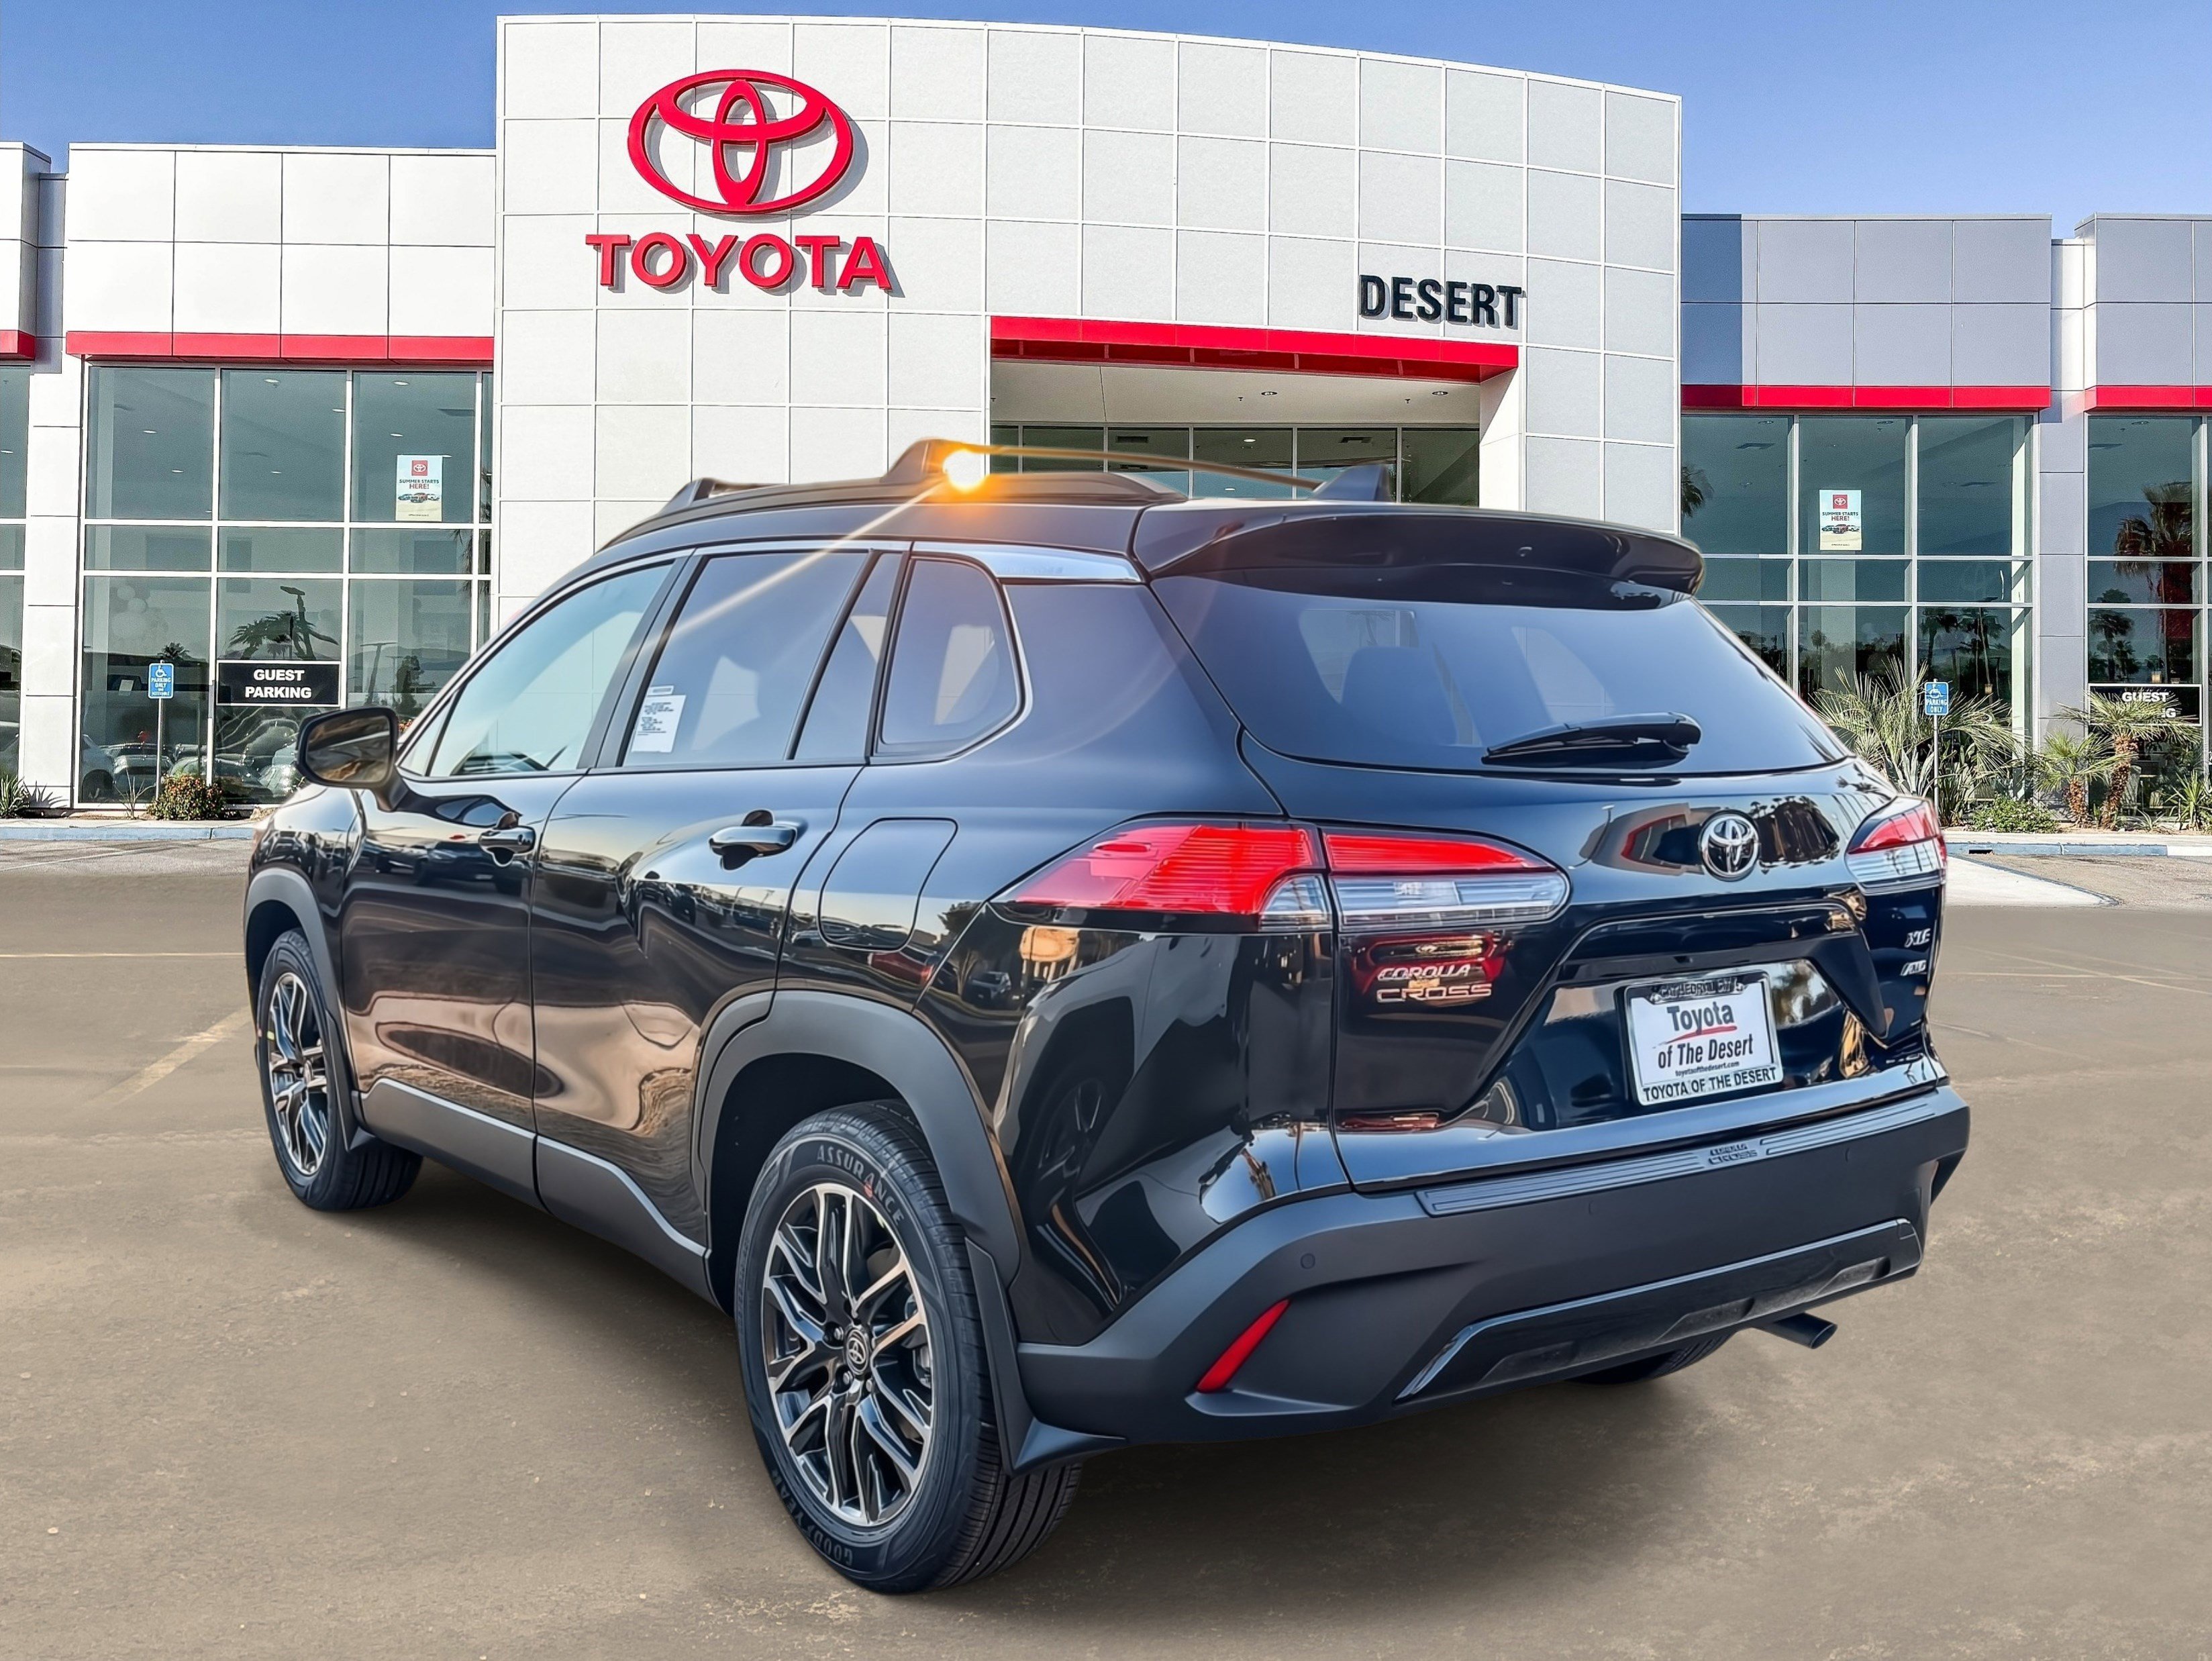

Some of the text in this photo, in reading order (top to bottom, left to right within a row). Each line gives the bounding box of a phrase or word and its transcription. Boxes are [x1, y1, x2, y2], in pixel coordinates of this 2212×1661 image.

[585, 232, 893, 290] TOYOTA
[1359, 274, 1522, 326] DESERT
[253, 669, 305, 681] GUEST
[245, 686, 312, 699] PARKING
[2121, 691, 2169, 703] GUEST
[1930, 705, 1944, 713] ONLY
[1377, 964, 1471, 981] COROLLA
[1376, 983, 1493, 1003] CROSS
[1666, 1001, 1735, 1036] Toyota
[1658, 1033, 1754, 1069] of The Desert
[1643, 1066, 1776, 1102] TOYOTA OF THE DESERT
[817, 1144, 905, 1225] ASSURANCE
